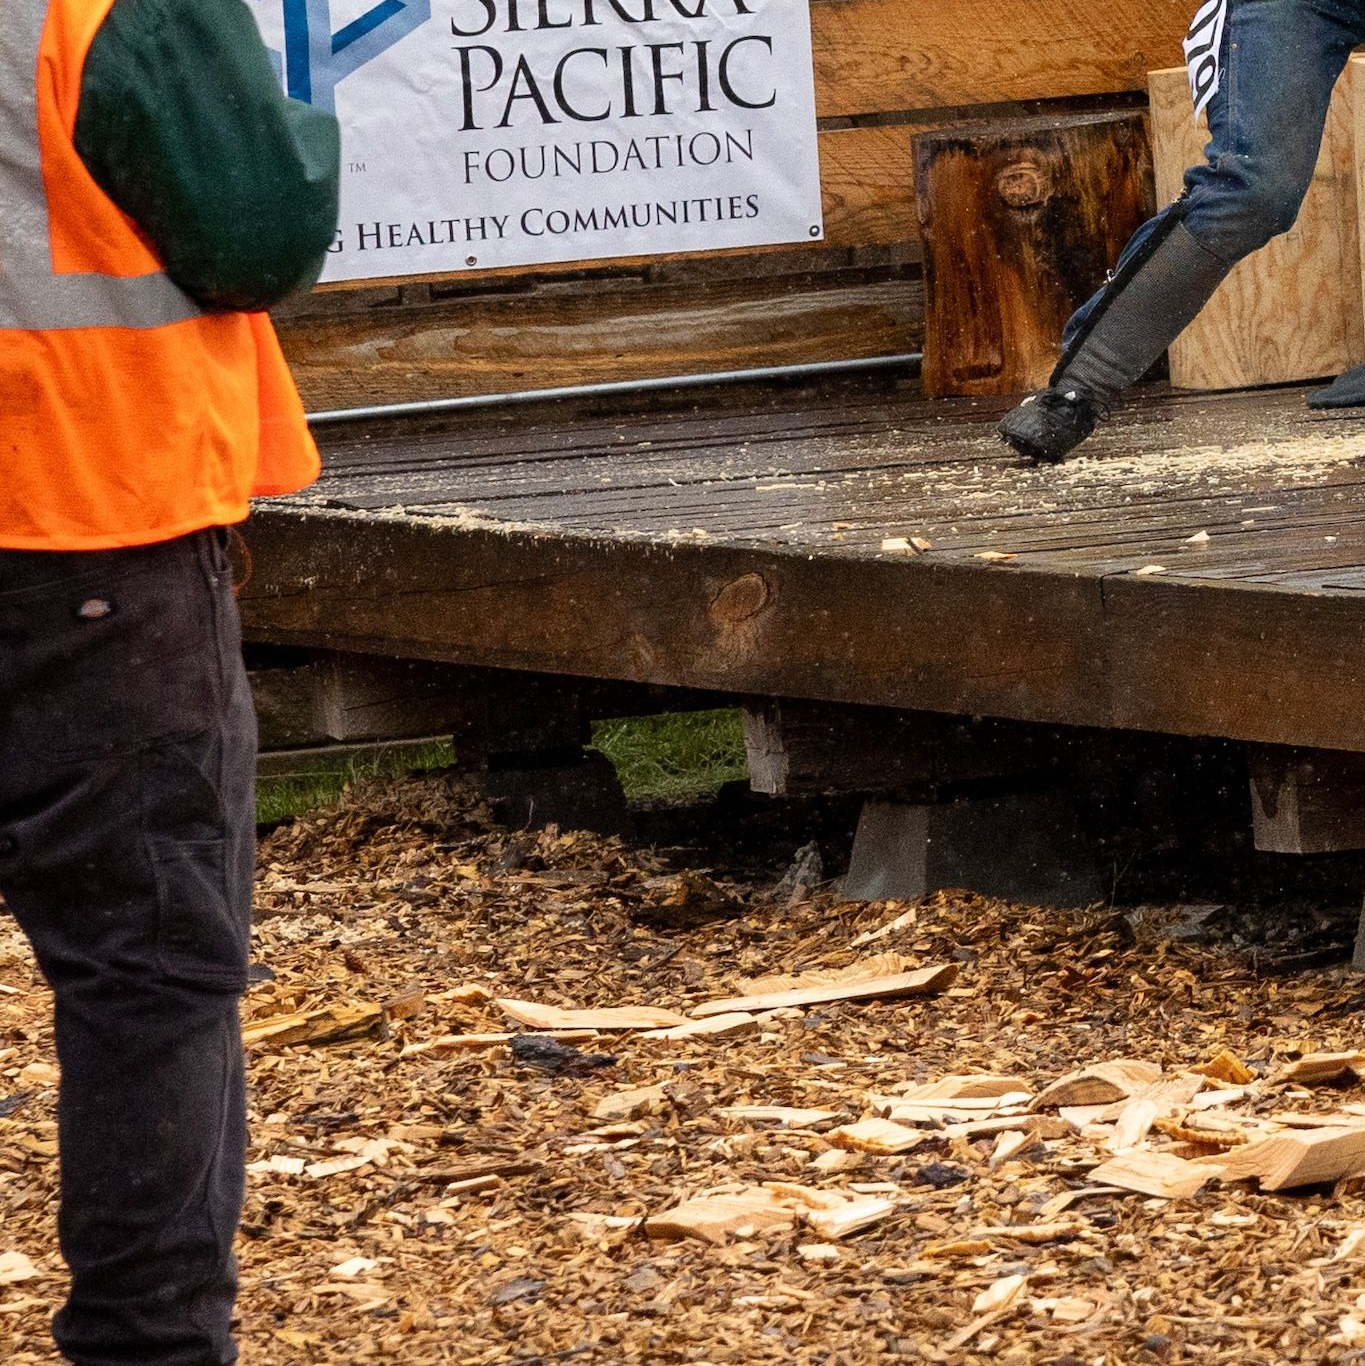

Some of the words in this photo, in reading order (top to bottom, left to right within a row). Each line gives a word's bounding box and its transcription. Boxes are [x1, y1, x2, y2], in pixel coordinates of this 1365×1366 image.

[451, 35, 777, 131] PACIFIC
[462, 129, 754, 184] FOUNDATION
[356, 214, 509, 251] HEALTHY
[519, 193, 760, 238] COMMUNITIES
